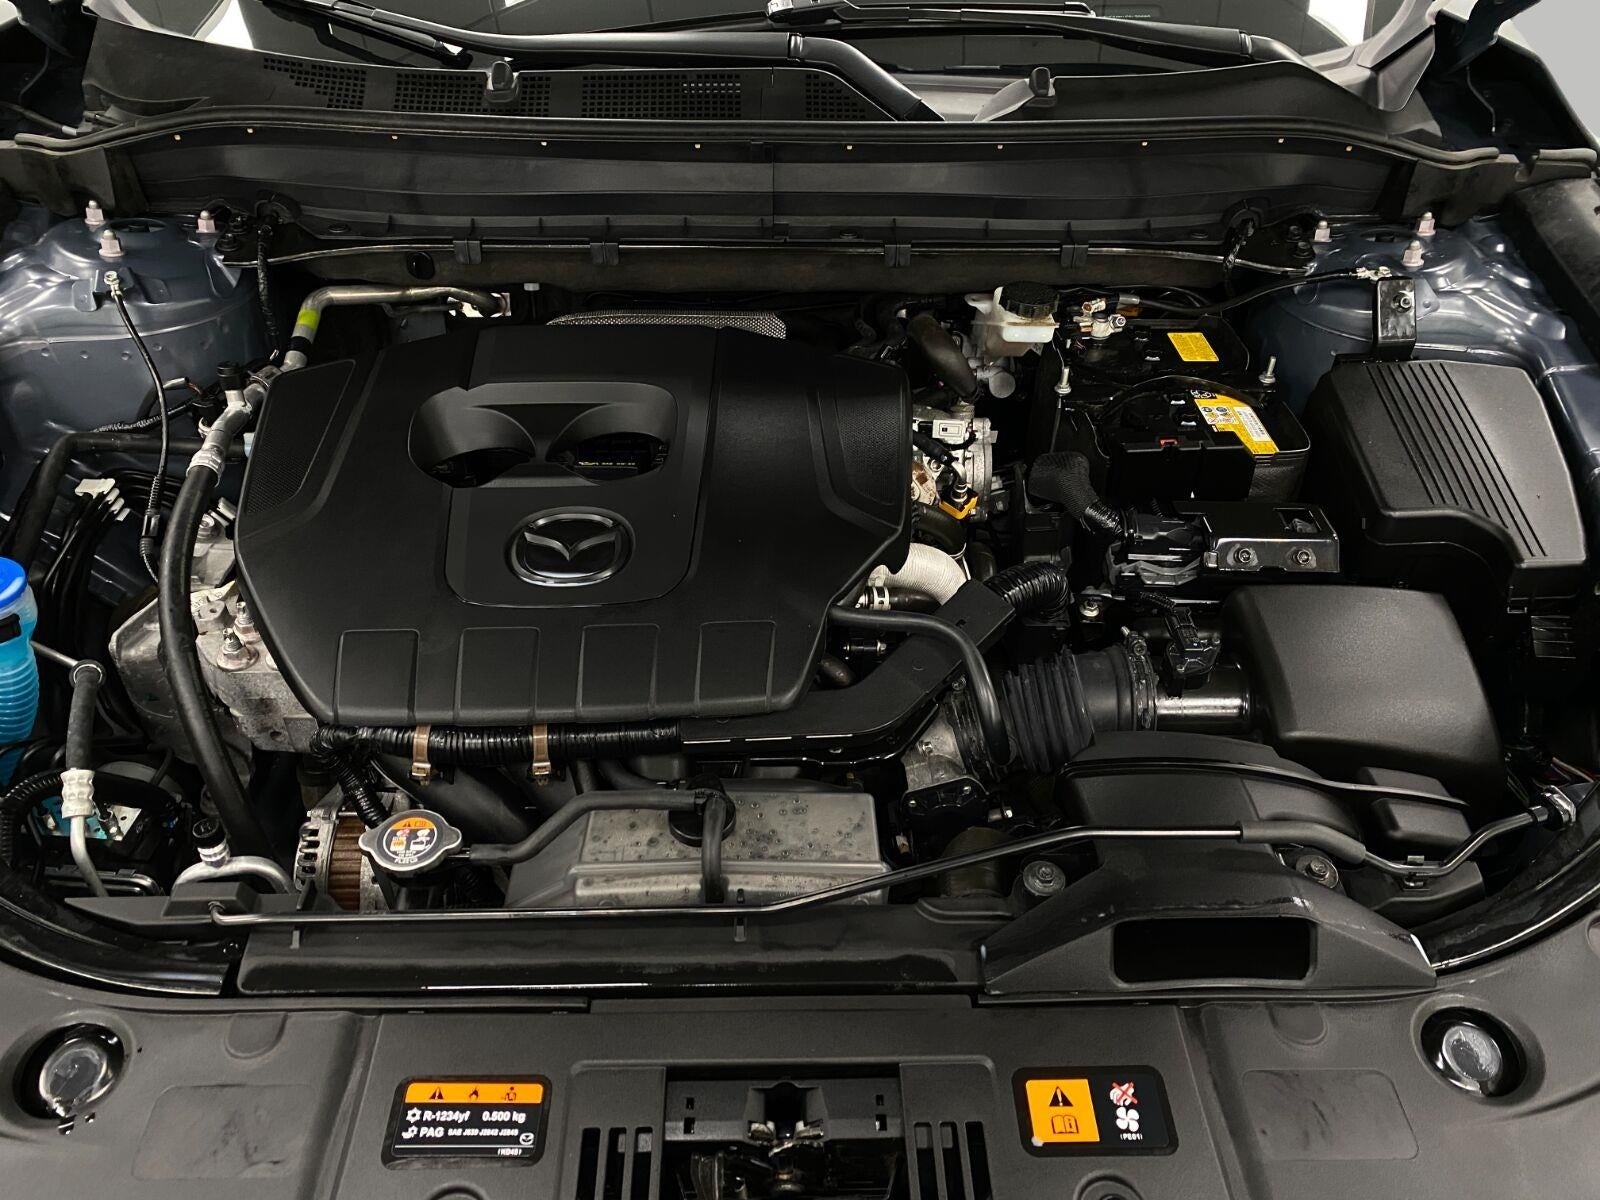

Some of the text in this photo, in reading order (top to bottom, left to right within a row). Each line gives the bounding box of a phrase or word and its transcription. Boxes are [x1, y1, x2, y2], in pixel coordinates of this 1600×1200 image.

[423, 1111, 526, 1123] R-1234yf 0.500 kg
[419, 1127, 444, 1138] PAG
